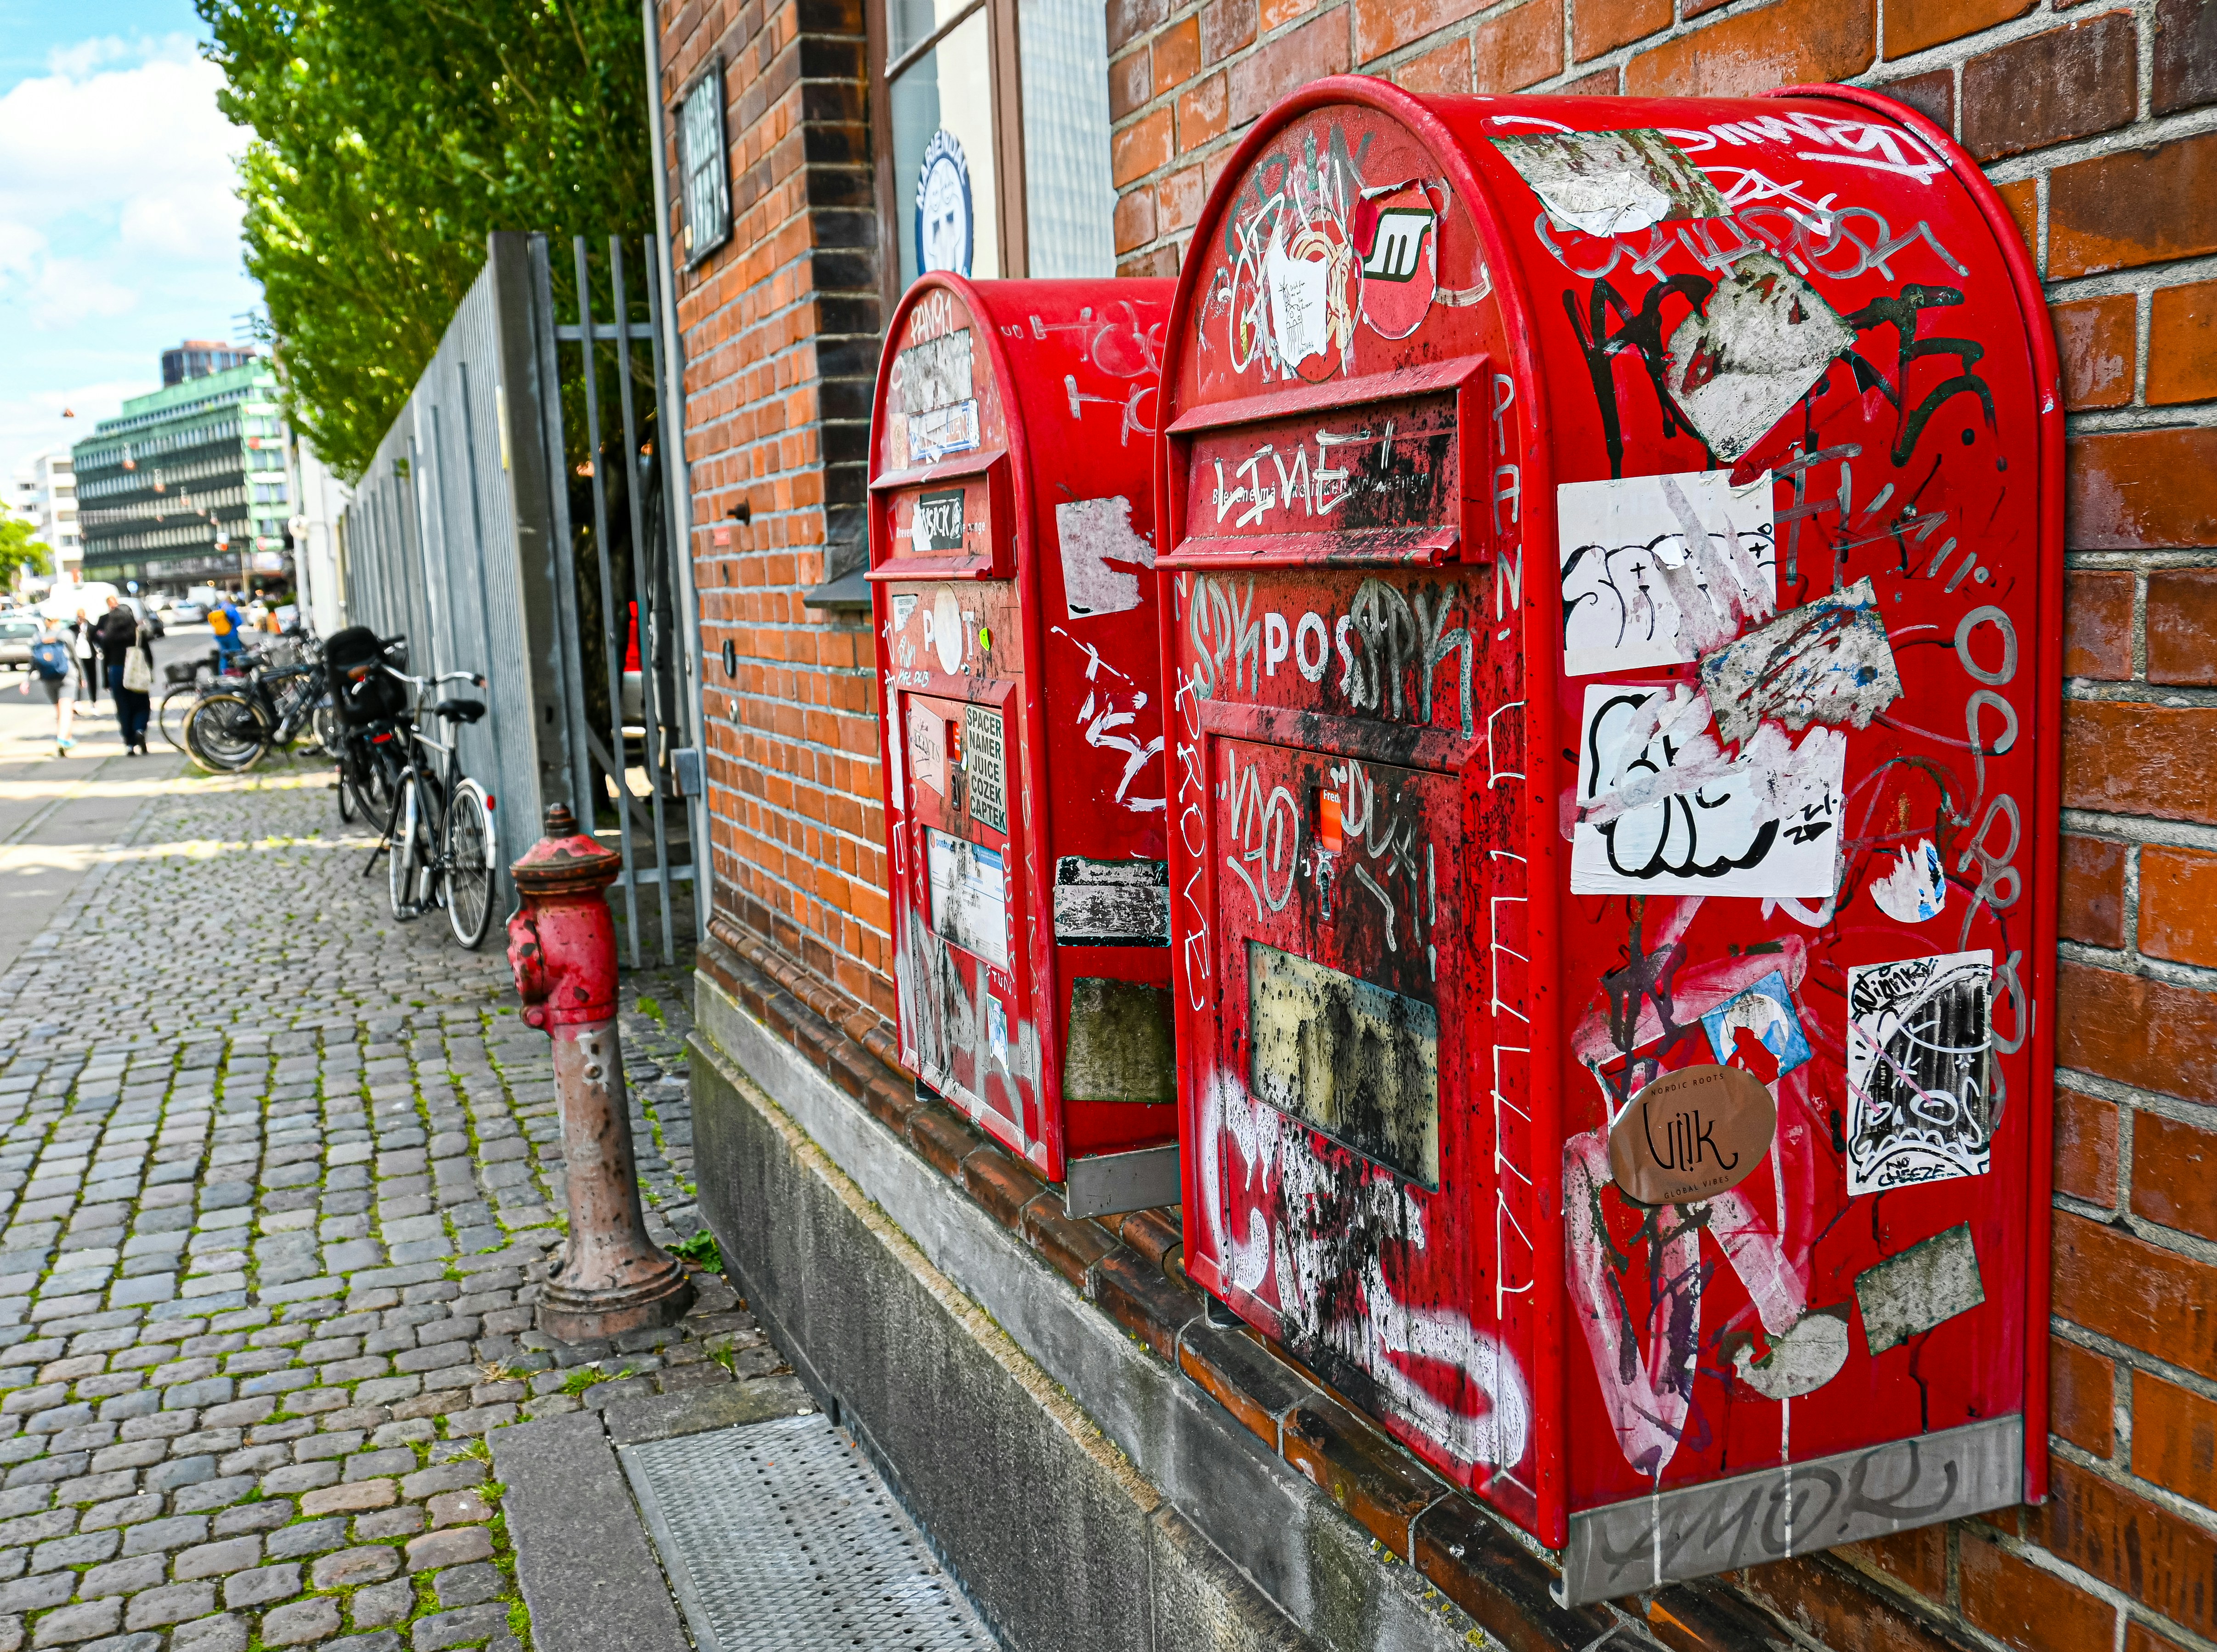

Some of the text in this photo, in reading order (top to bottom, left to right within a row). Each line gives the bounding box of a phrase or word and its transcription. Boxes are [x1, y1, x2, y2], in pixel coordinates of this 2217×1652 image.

[923, 610, 975, 657] PT
[967, 707, 1002, 739] SPACER
[969, 730, 1002, 761] NAMER
[973, 754, 1000, 783] JUICE
[971, 775, 1002, 807] COZEK
[1323, 789, 1341, 804] Fred
[970, 795, 1005, 831] CAPTEK
[1651, 1073, 1724, 1096] NORDIC ROOTS
[1664, 1175, 1729, 1199] GLOBAL VIBES
